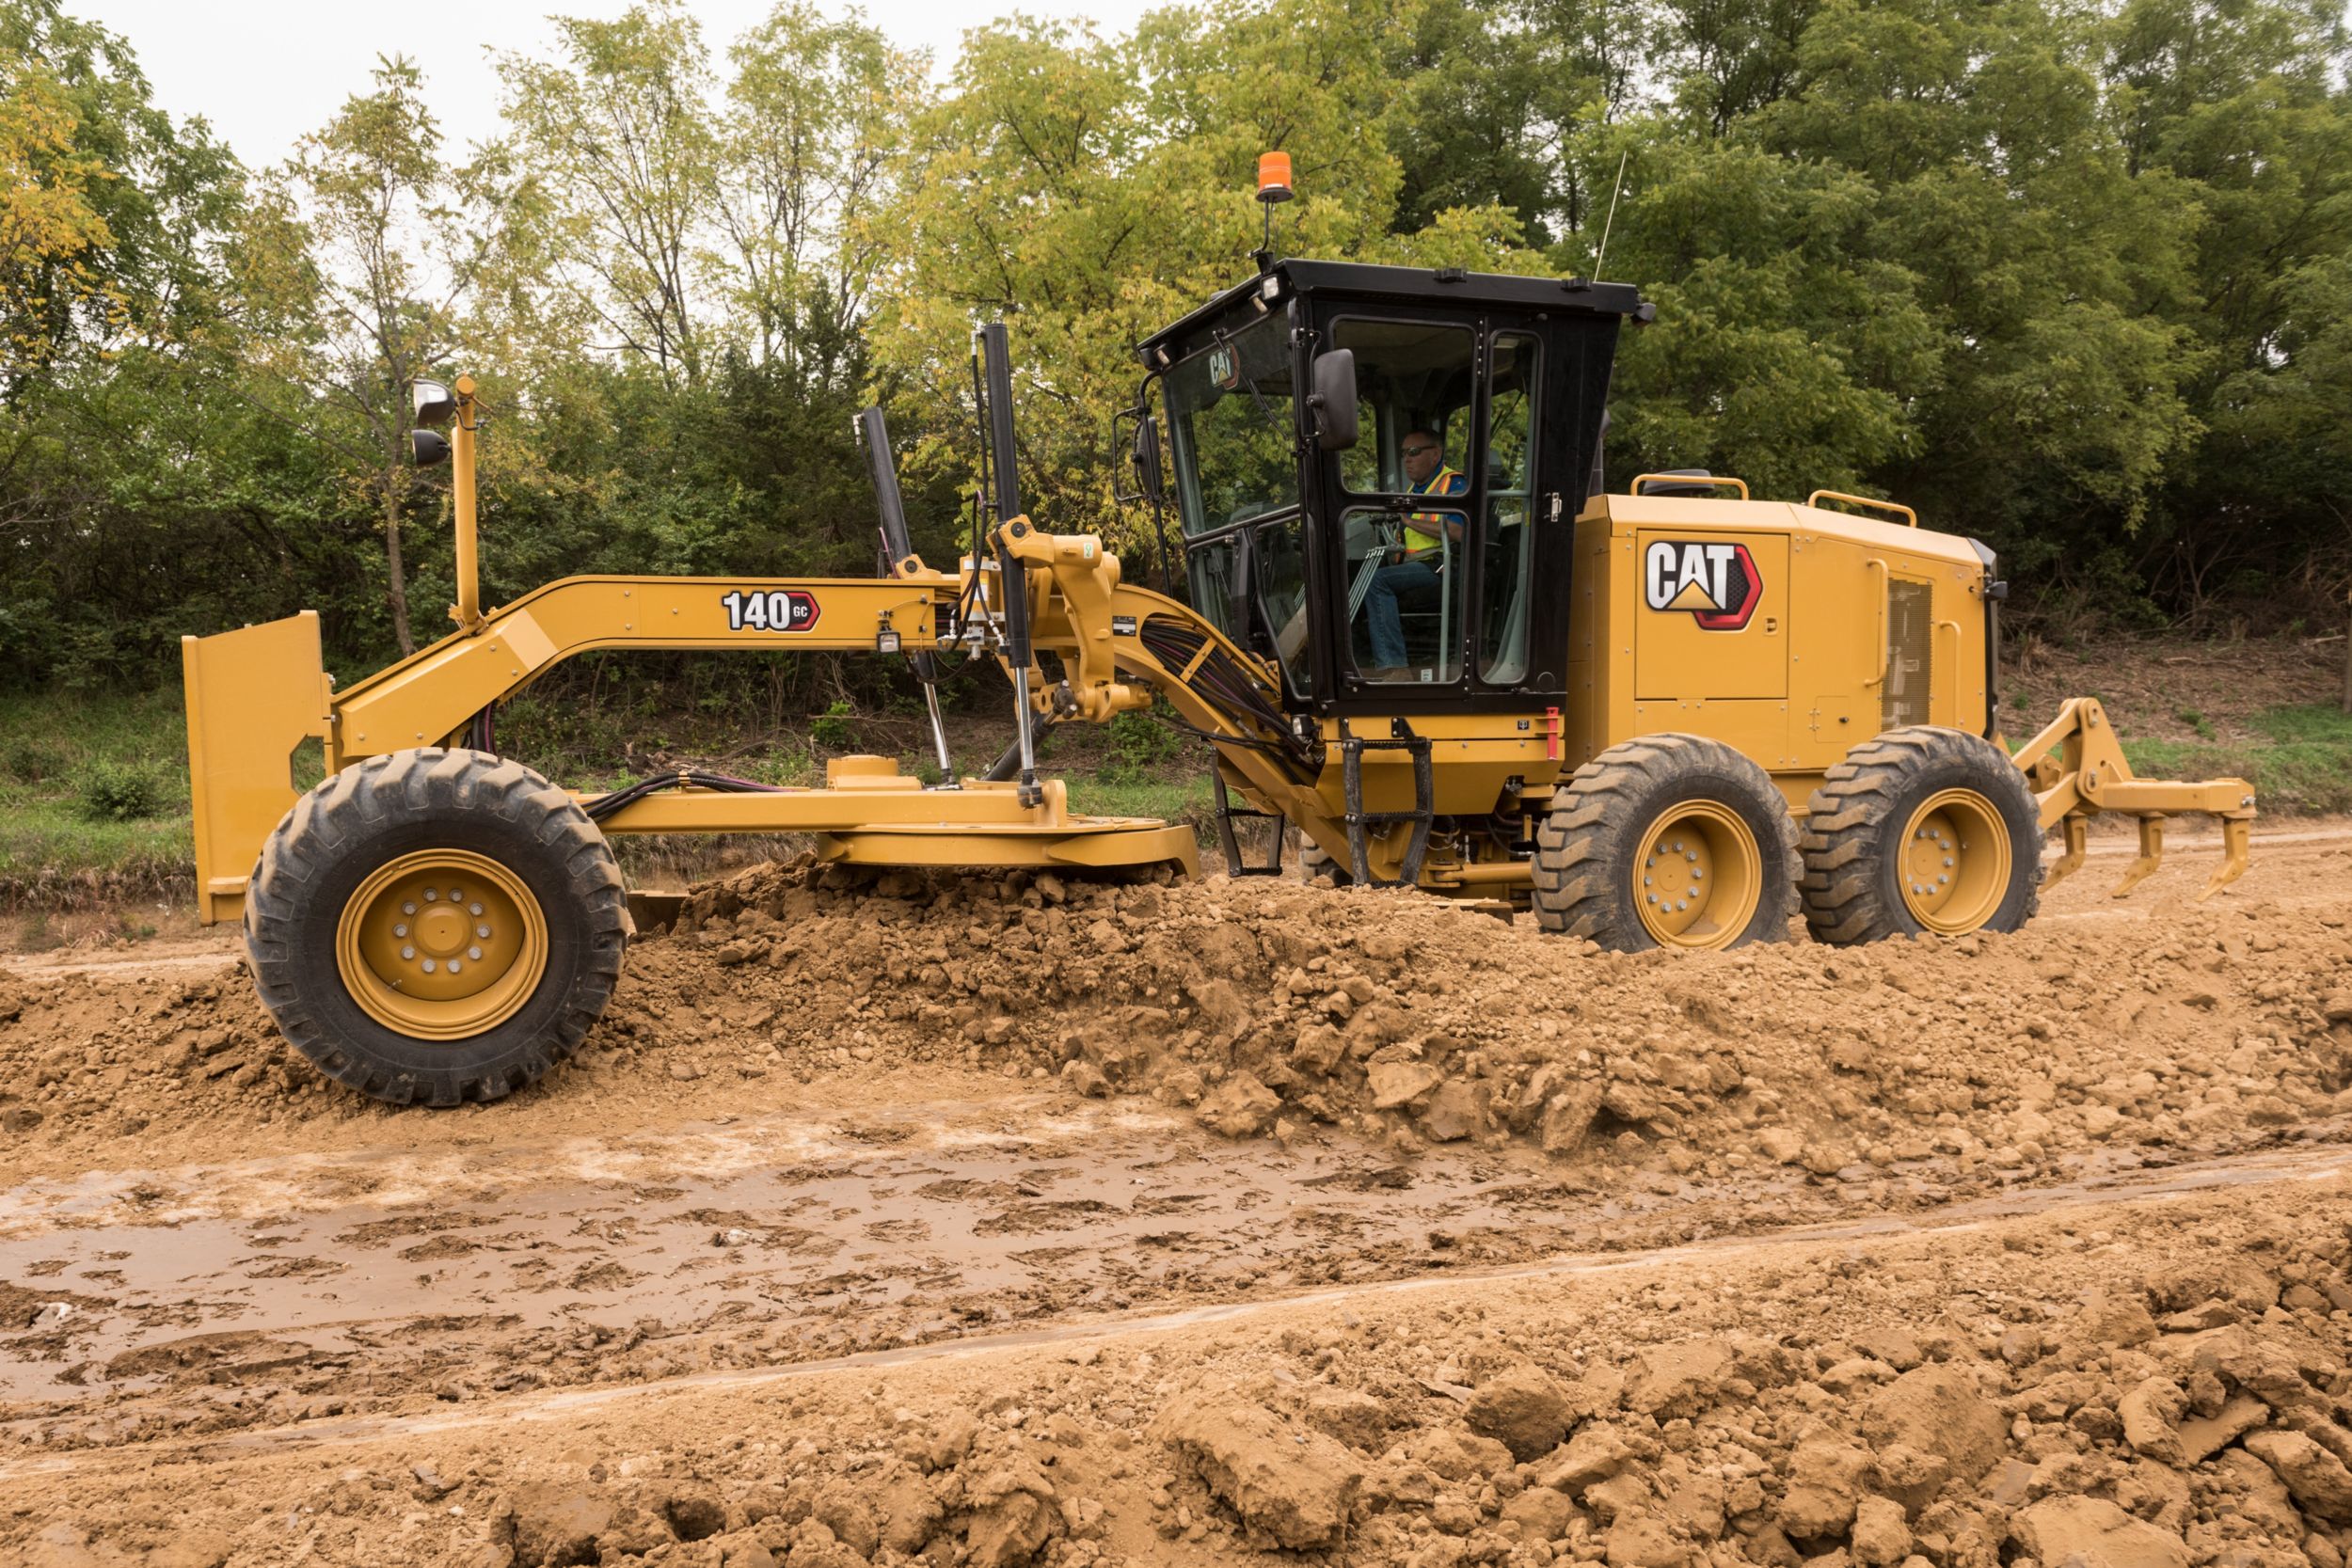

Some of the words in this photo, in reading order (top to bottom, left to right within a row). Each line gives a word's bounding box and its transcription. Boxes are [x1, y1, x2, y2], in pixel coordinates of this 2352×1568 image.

[1210, 347, 1232, 385] CAT
[1646, 542, 1735, 610] CAT
[723, 592, 790, 629] 140
[793, 606, 808, 617] GC
